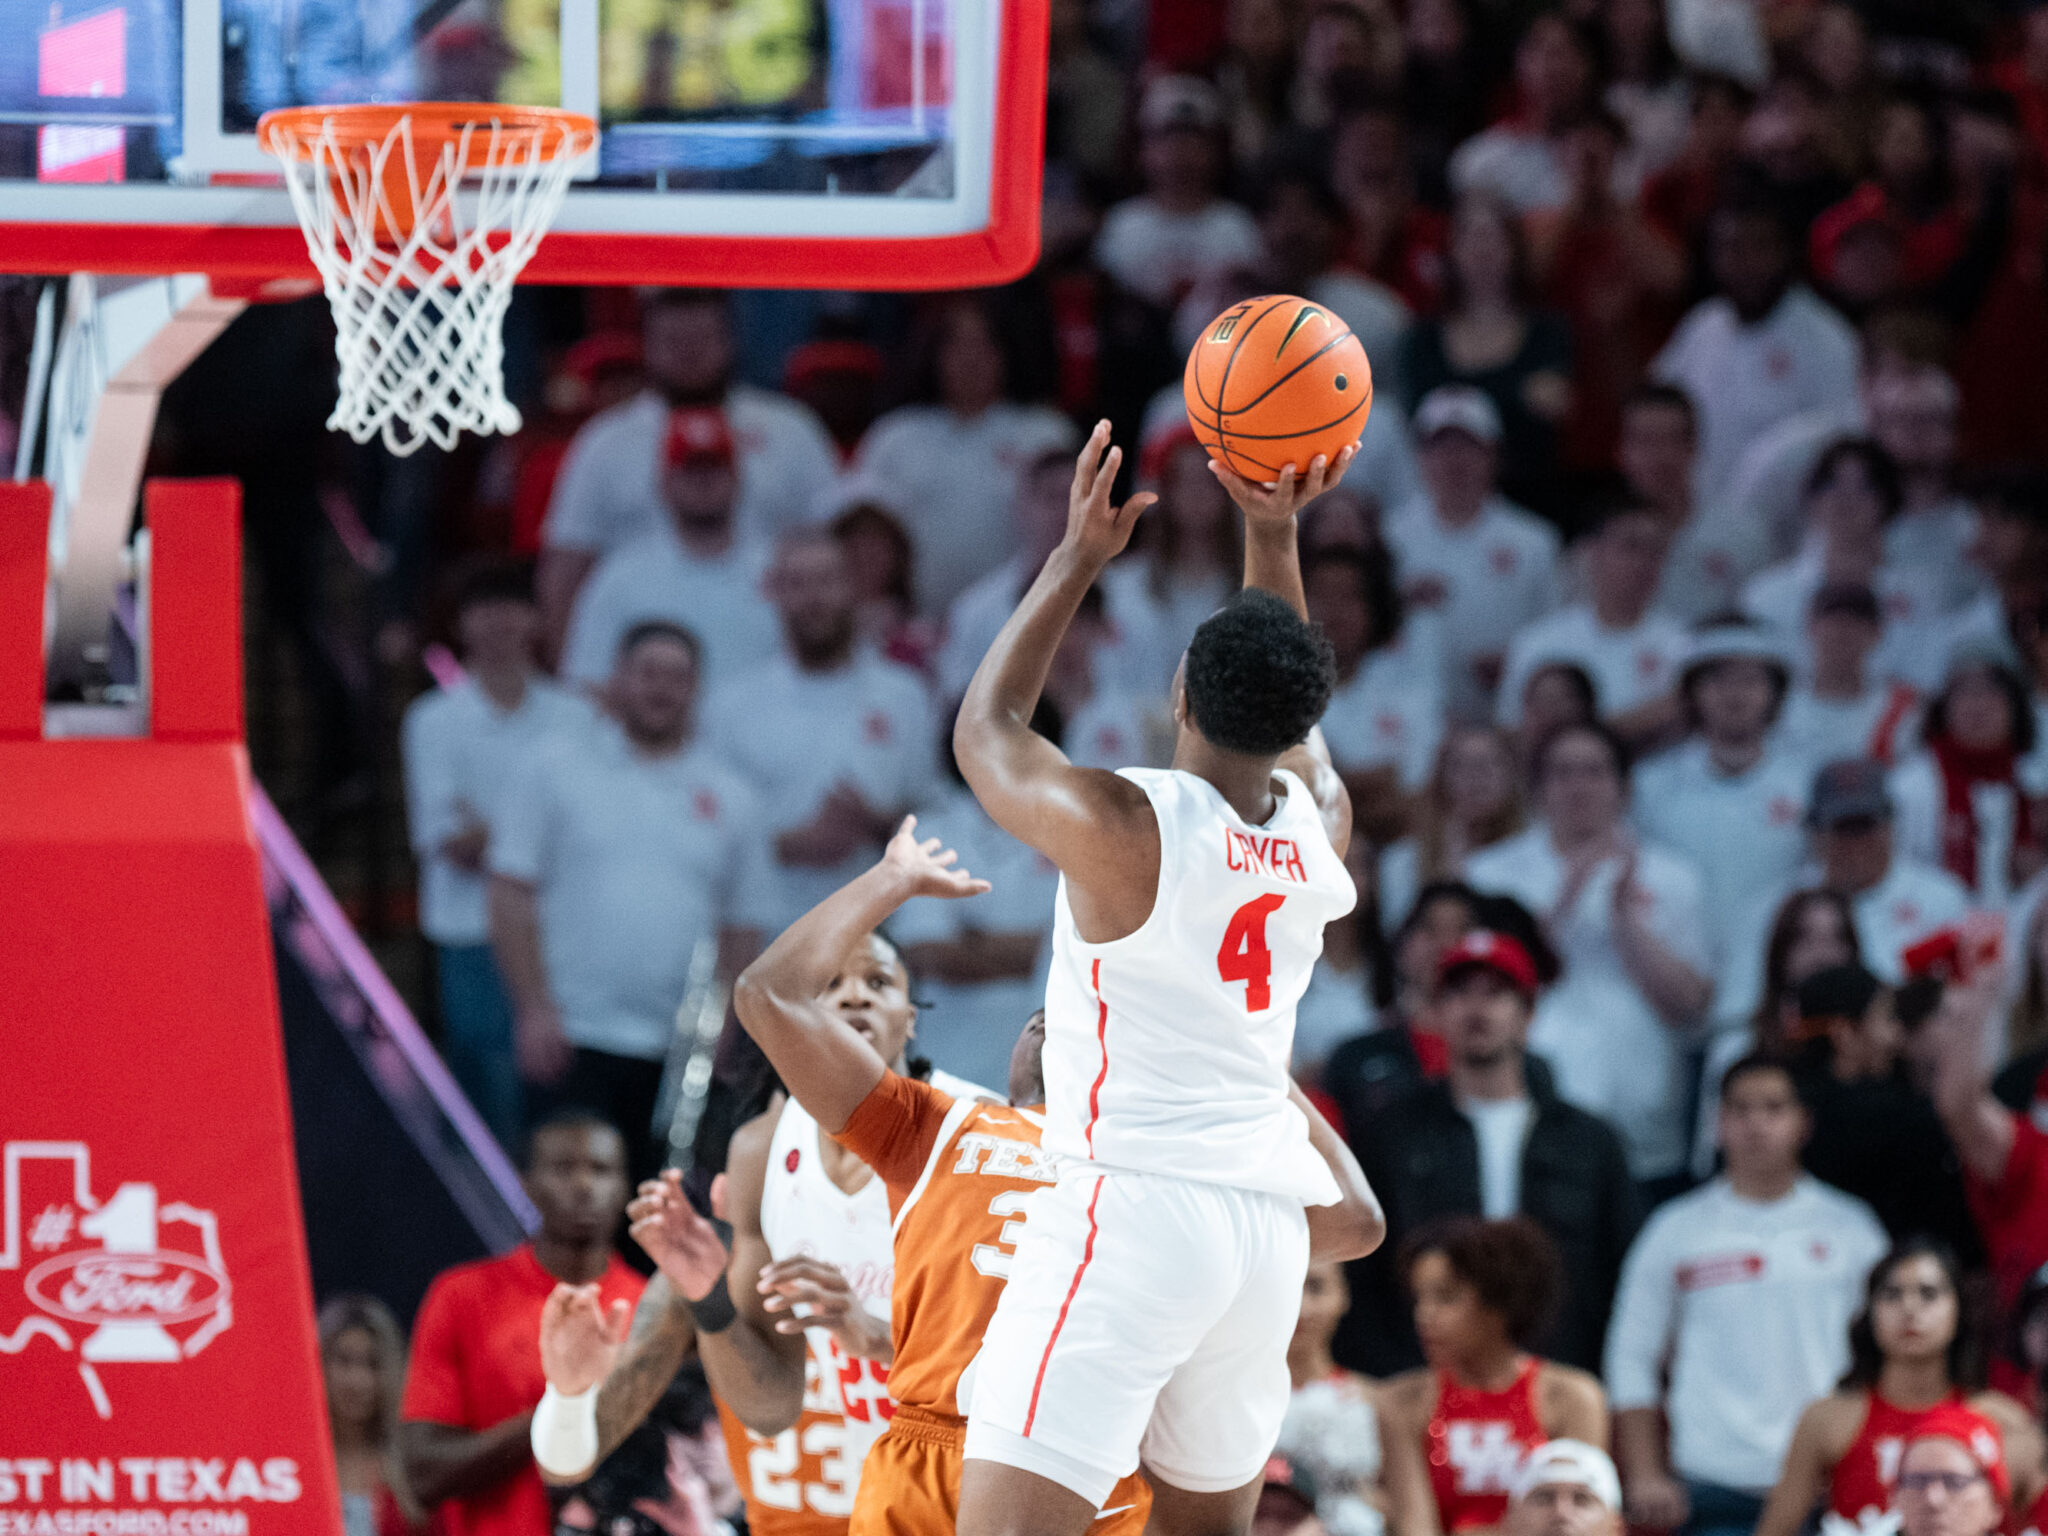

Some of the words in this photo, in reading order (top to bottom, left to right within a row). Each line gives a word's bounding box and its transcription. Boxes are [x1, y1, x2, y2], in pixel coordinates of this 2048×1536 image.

[1217, 893, 1287, 1013] 4
[60, 1260, 194, 1313] Ford
[59, 1457, 115, 1502] IN
[118, 1456, 302, 1503] TEXAS
[746, 1423, 855, 1517] 23
